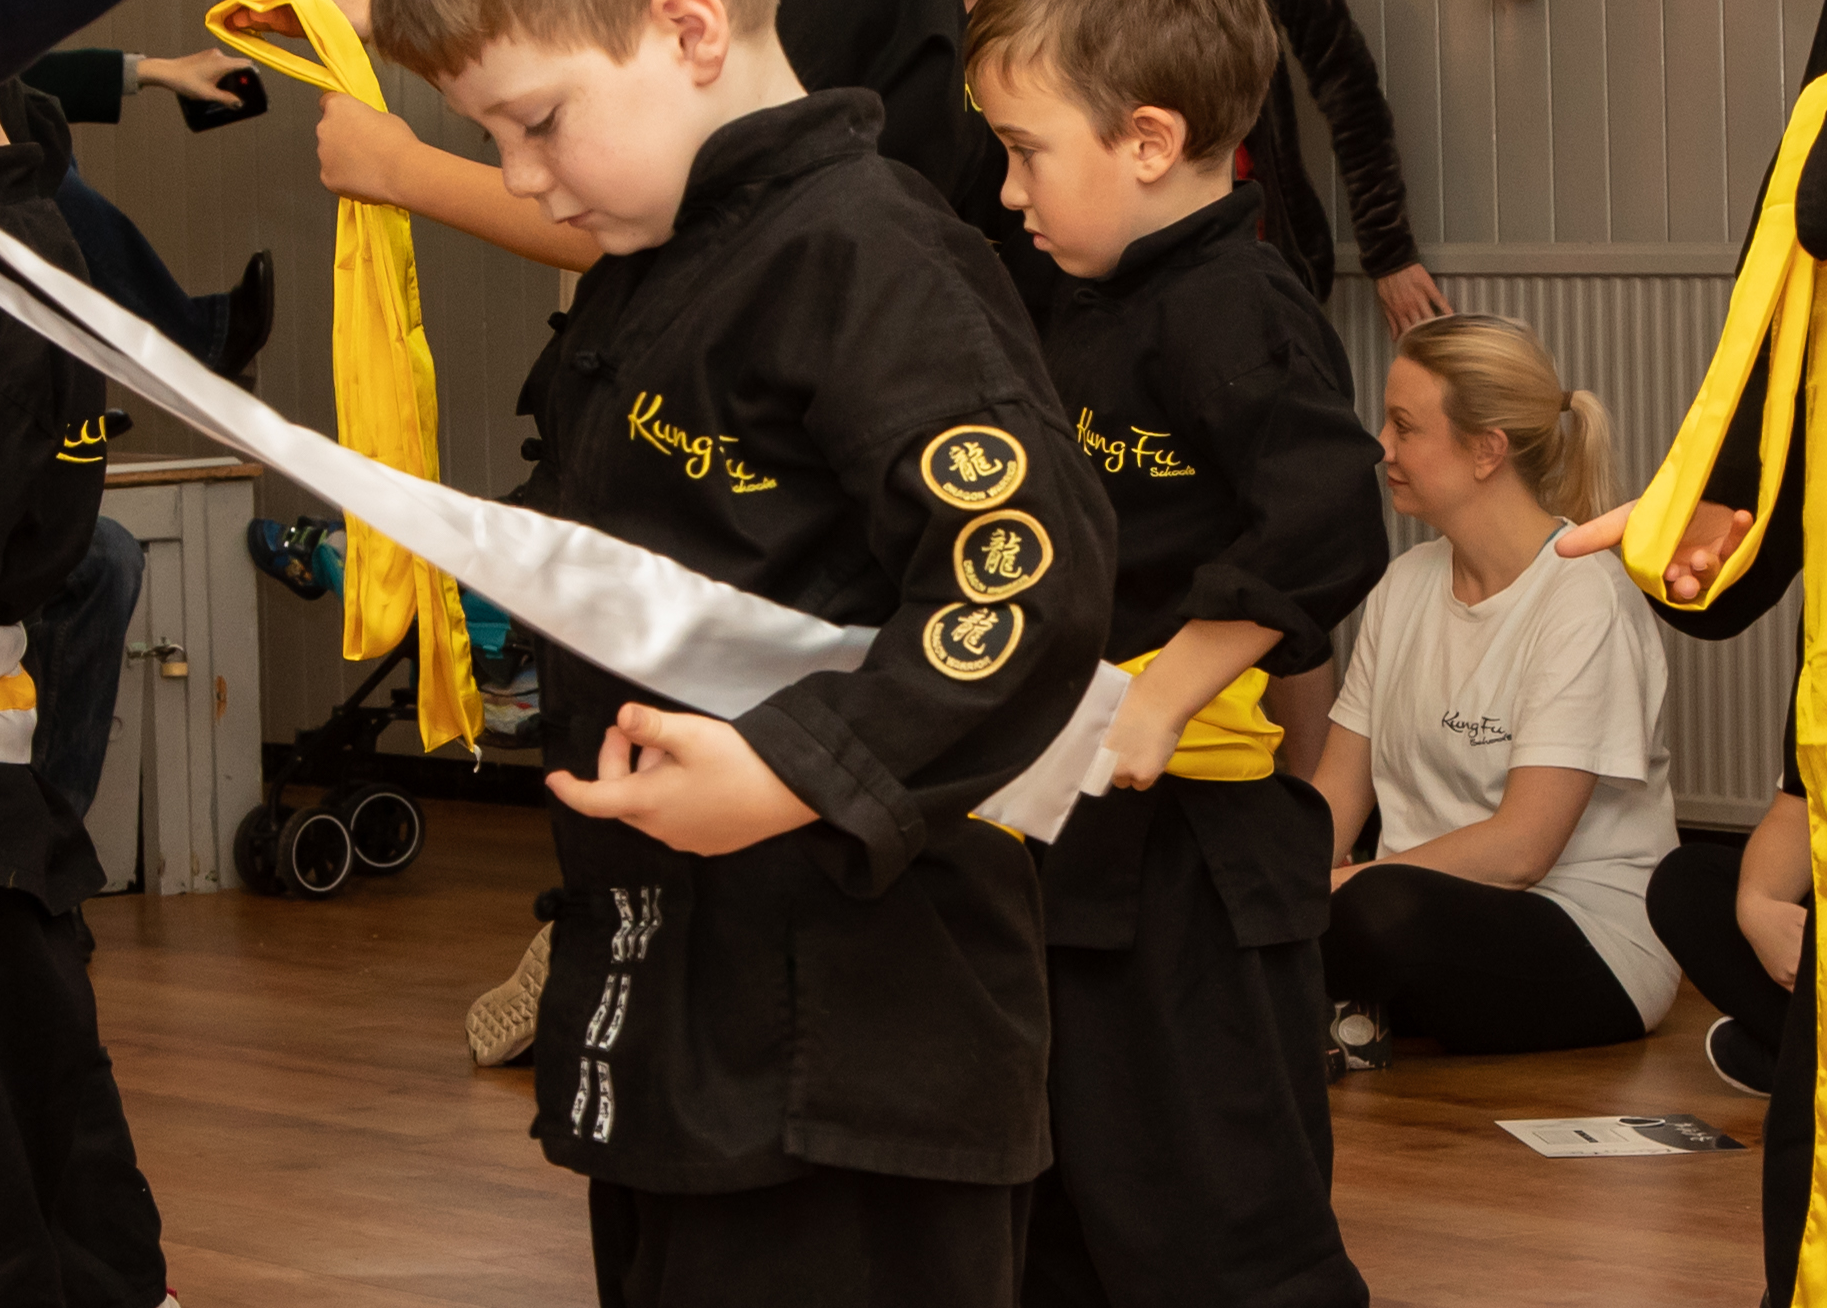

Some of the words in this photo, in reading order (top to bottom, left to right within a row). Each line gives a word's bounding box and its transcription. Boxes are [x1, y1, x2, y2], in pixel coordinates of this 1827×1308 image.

[627, 391, 713, 479] Kung
[1076, 406, 1126, 473] Kung
[1130, 425, 1182, 468] Fu
[1442, 711, 1479, 738] Kung
[1480, 716, 1505, 734] Fu
